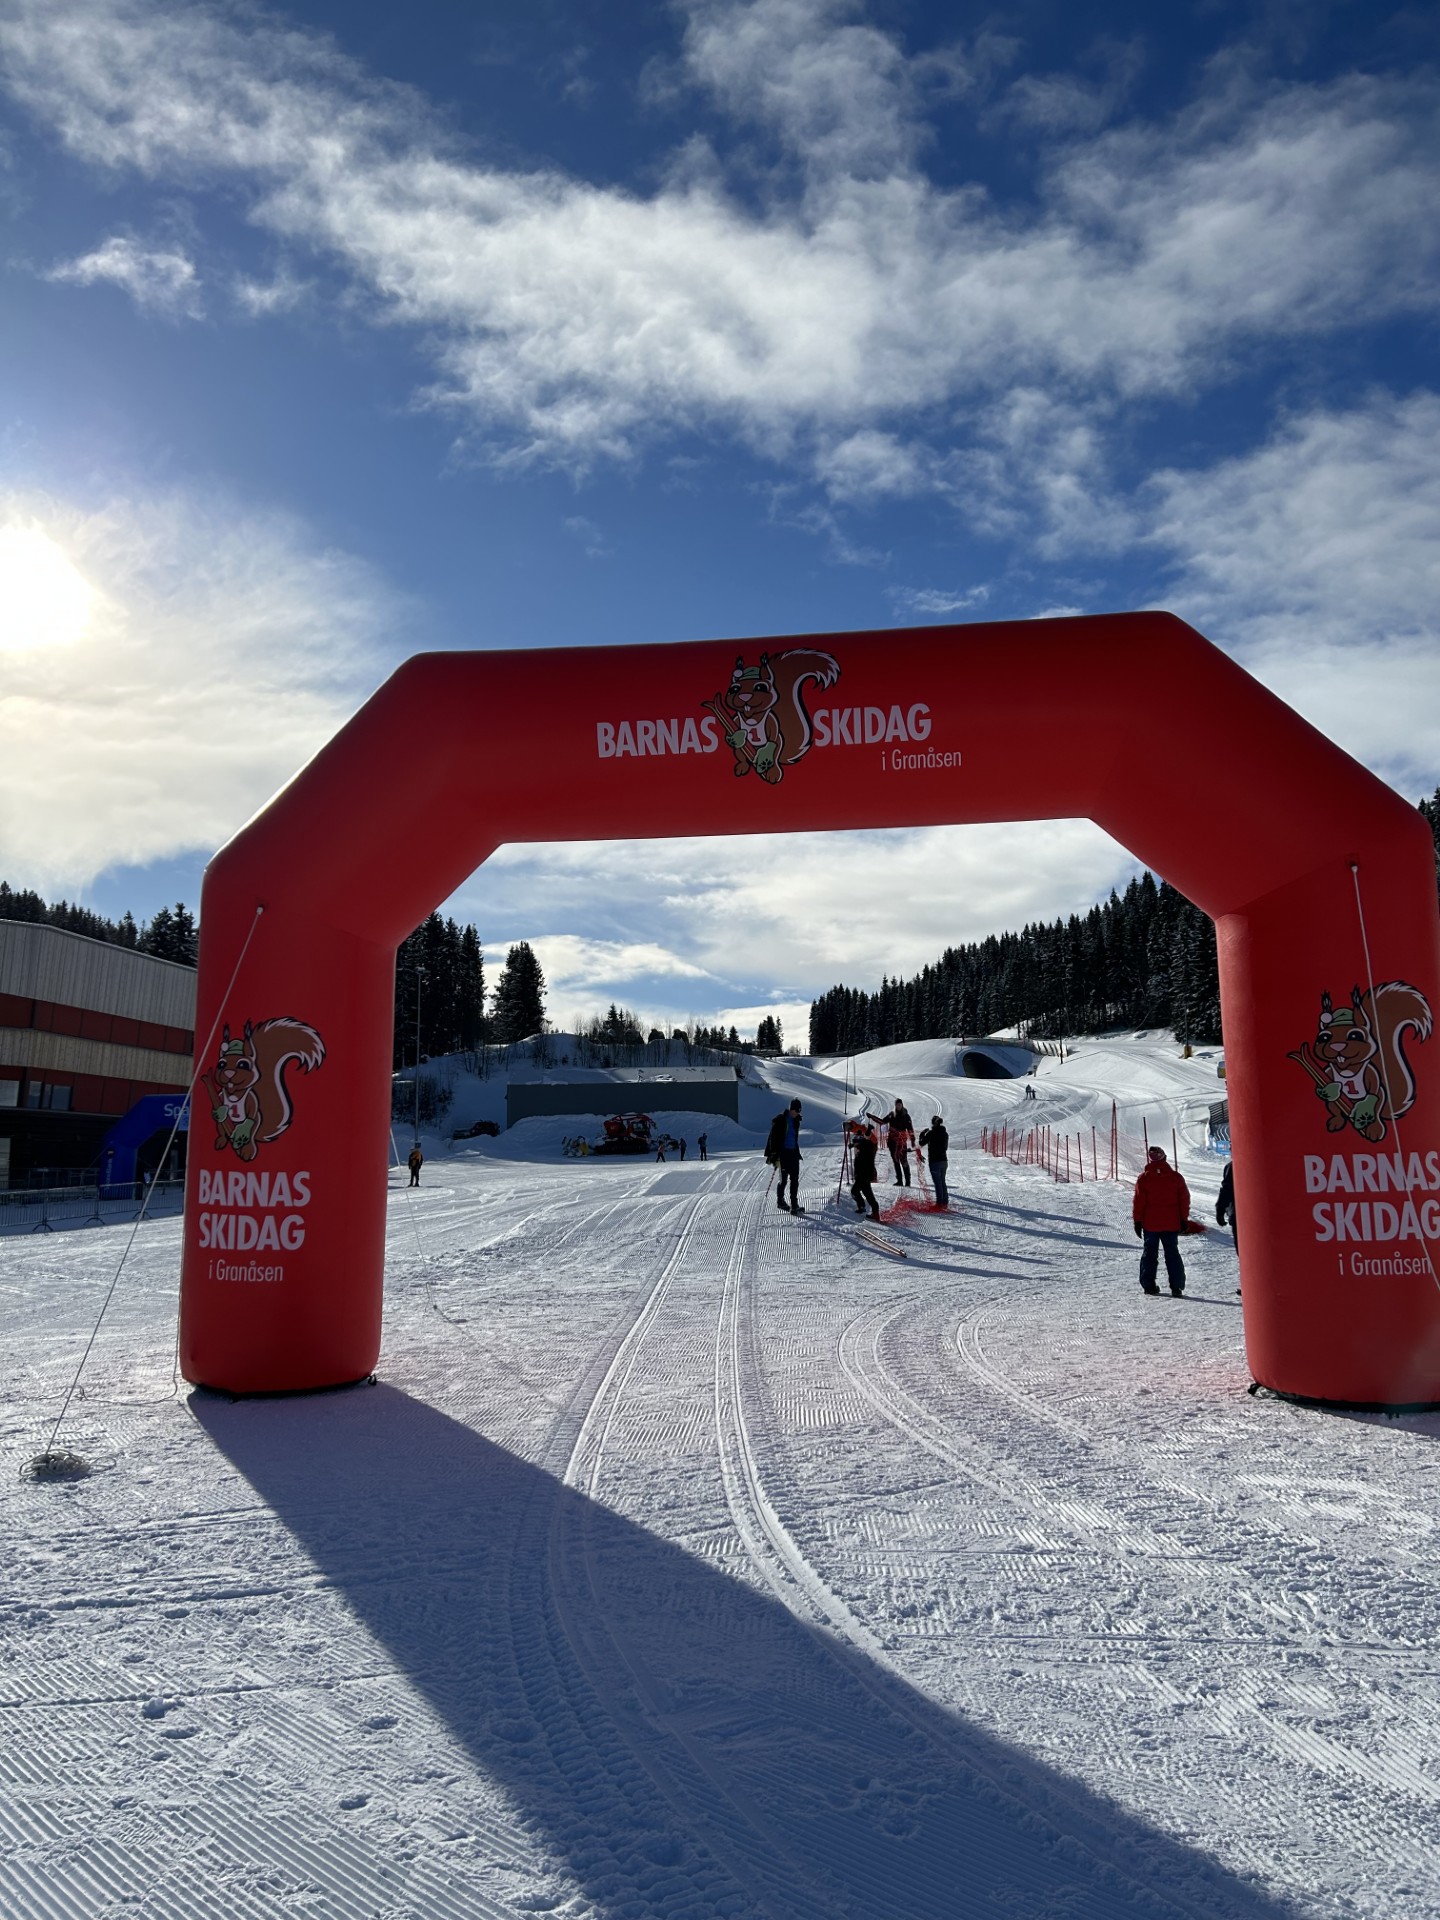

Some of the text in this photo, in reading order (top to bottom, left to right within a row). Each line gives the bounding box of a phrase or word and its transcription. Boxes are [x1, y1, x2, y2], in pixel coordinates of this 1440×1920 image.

[597, 703, 932, 758] BARNAS SKIDAG
[891, 747, 963, 771] Granåsen
[163, 1103, 190, 1120] Spa
[199, 1169, 311, 1208] BARNAS
[1303, 1151, 1440, 1194] BARNAS
[199, 1211, 306, 1251] SKIDAG
[1312, 1199, 1440, 1242] SKIDAG
[216, 1260, 283, 1282] Granåsen
[1338, 1251, 1432, 1276] i Granåsen
